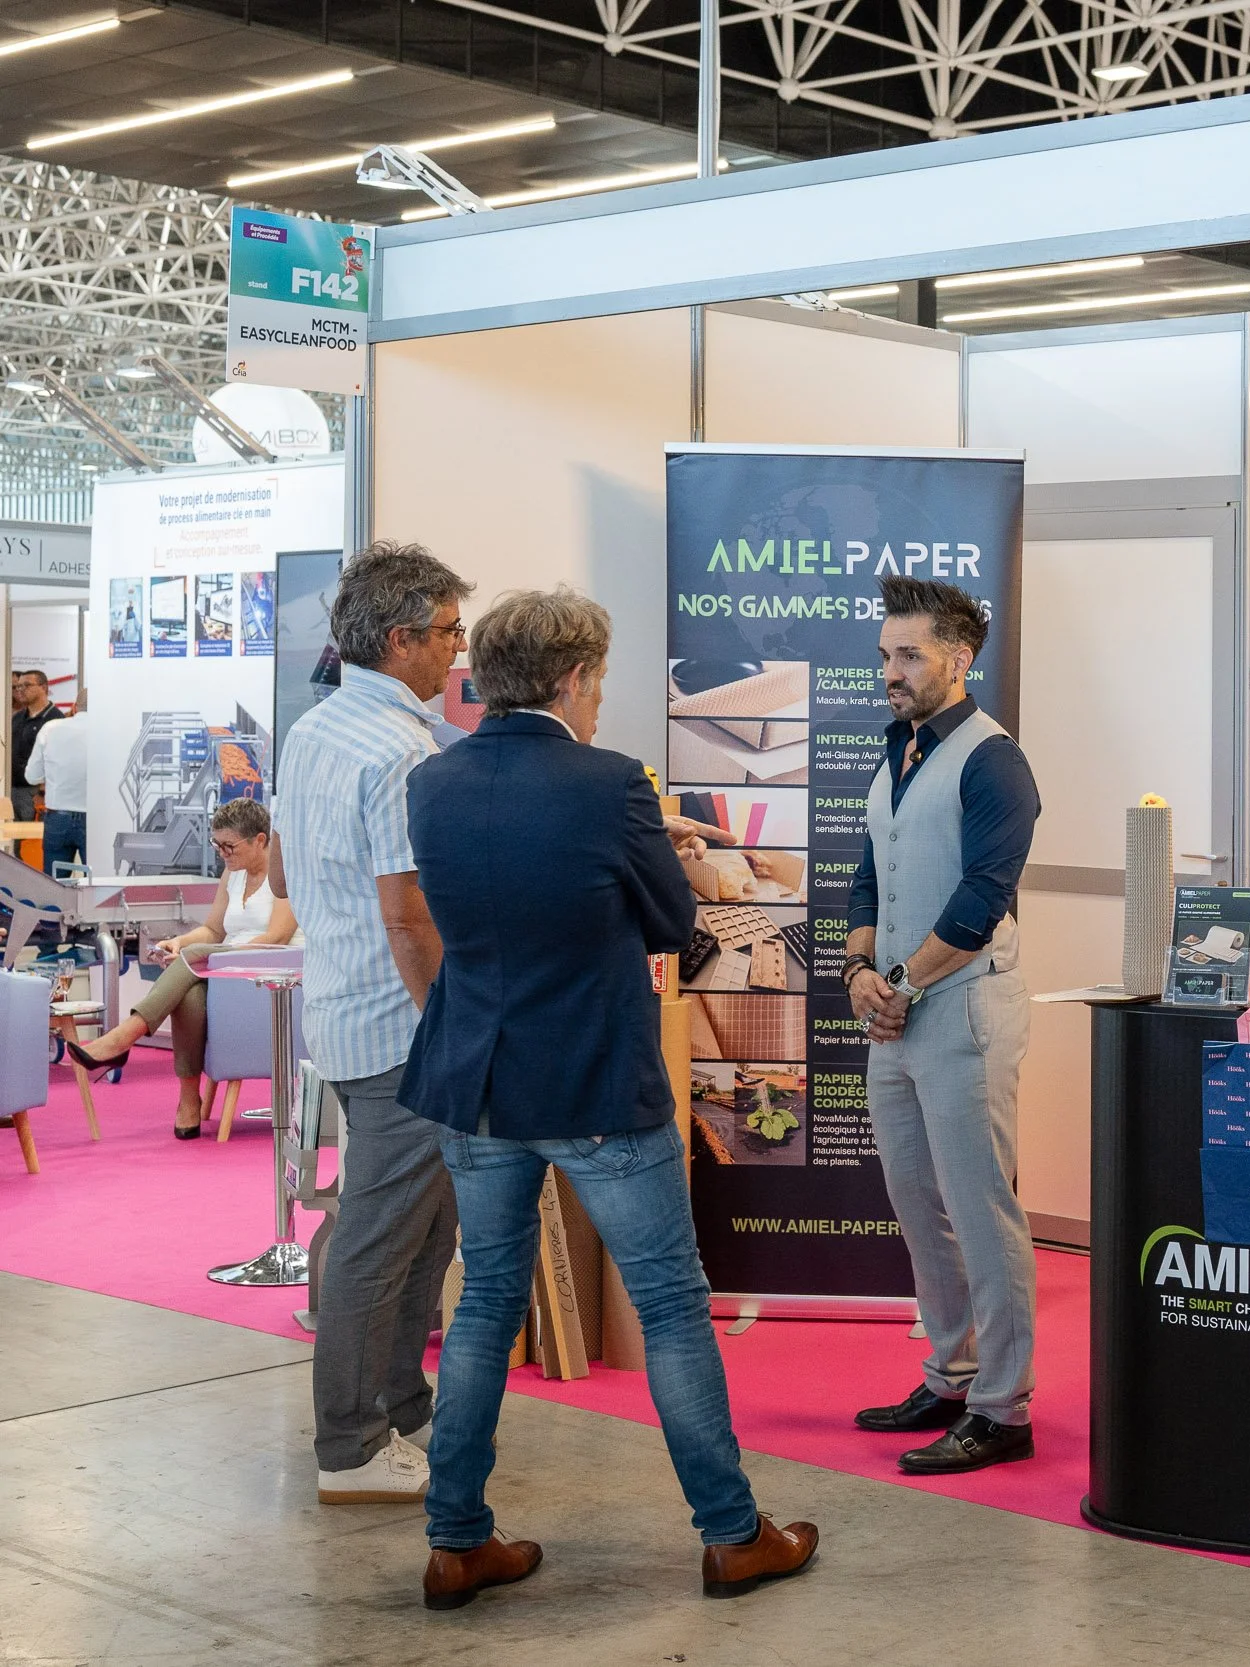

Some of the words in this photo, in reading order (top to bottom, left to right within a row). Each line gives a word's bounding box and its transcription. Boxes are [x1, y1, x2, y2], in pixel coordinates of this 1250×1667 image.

[248, 280, 268, 289] stand
[292, 267, 359, 302] F142
[311, 318, 350, 335] MCTM
[240, 325, 357, 351] EASYCLEANFOOD
[159, 494, 179, 508] Votre
[181, 492, 203, 508] projet
[204, 491, 213, 504] de
[215, 487, 271, 503] modernisation
[159, 513, 167, 524] de
[168, 514, 193, 526] process
[195, 510, 231, 522] alimentaire
[244, 510, 253, 519] en
[254, 507, 271, 518] main
[706, 538, 981, 578] AMIELPAPER
[678, 593, 733, 618] NOS
[739, 595, 849, 620] GAMMES
[855, 597, 884, 621] DE
[816, 668, 873, 679] PAPIERS
[815, 680, 875, 691] /CALAGE
[816, 696, 848, 706] Macule,
[850, 697, 870, 706] kraft,
[815, 750, 860, 760] Anti-Glisse
[861, 751, 885, 760] /Anti-
[815, 761, 851, 770] redoublé
[815, 813, 856, 823] Protection
[815, 825, 853, 834] sensibles
[854, 826, 863, 834] et
[814, 879, 848, 888] Cuisson
[814, 1035, 840, 1045] Papier
[842, 1036, 860, 1045] kraft
[814, 1073, 862, 1084] PAPIER
[814, 1085, 867, 1097] BIODÉG
[813, 1114, 859, 1124] NovaMulch
[813, 1125, 857, 1136] écologique
[813, 1136, 859, 1146] l'agriculture
[861, 1137, 869, 1145] et
[830, 1158, 862, 1167] plantes.
[1160, 1294, 1185, 1308] THE
[1188, 1297, 1232, 1313] SMART
[1160, 1311, 1188, 1325] FOR
